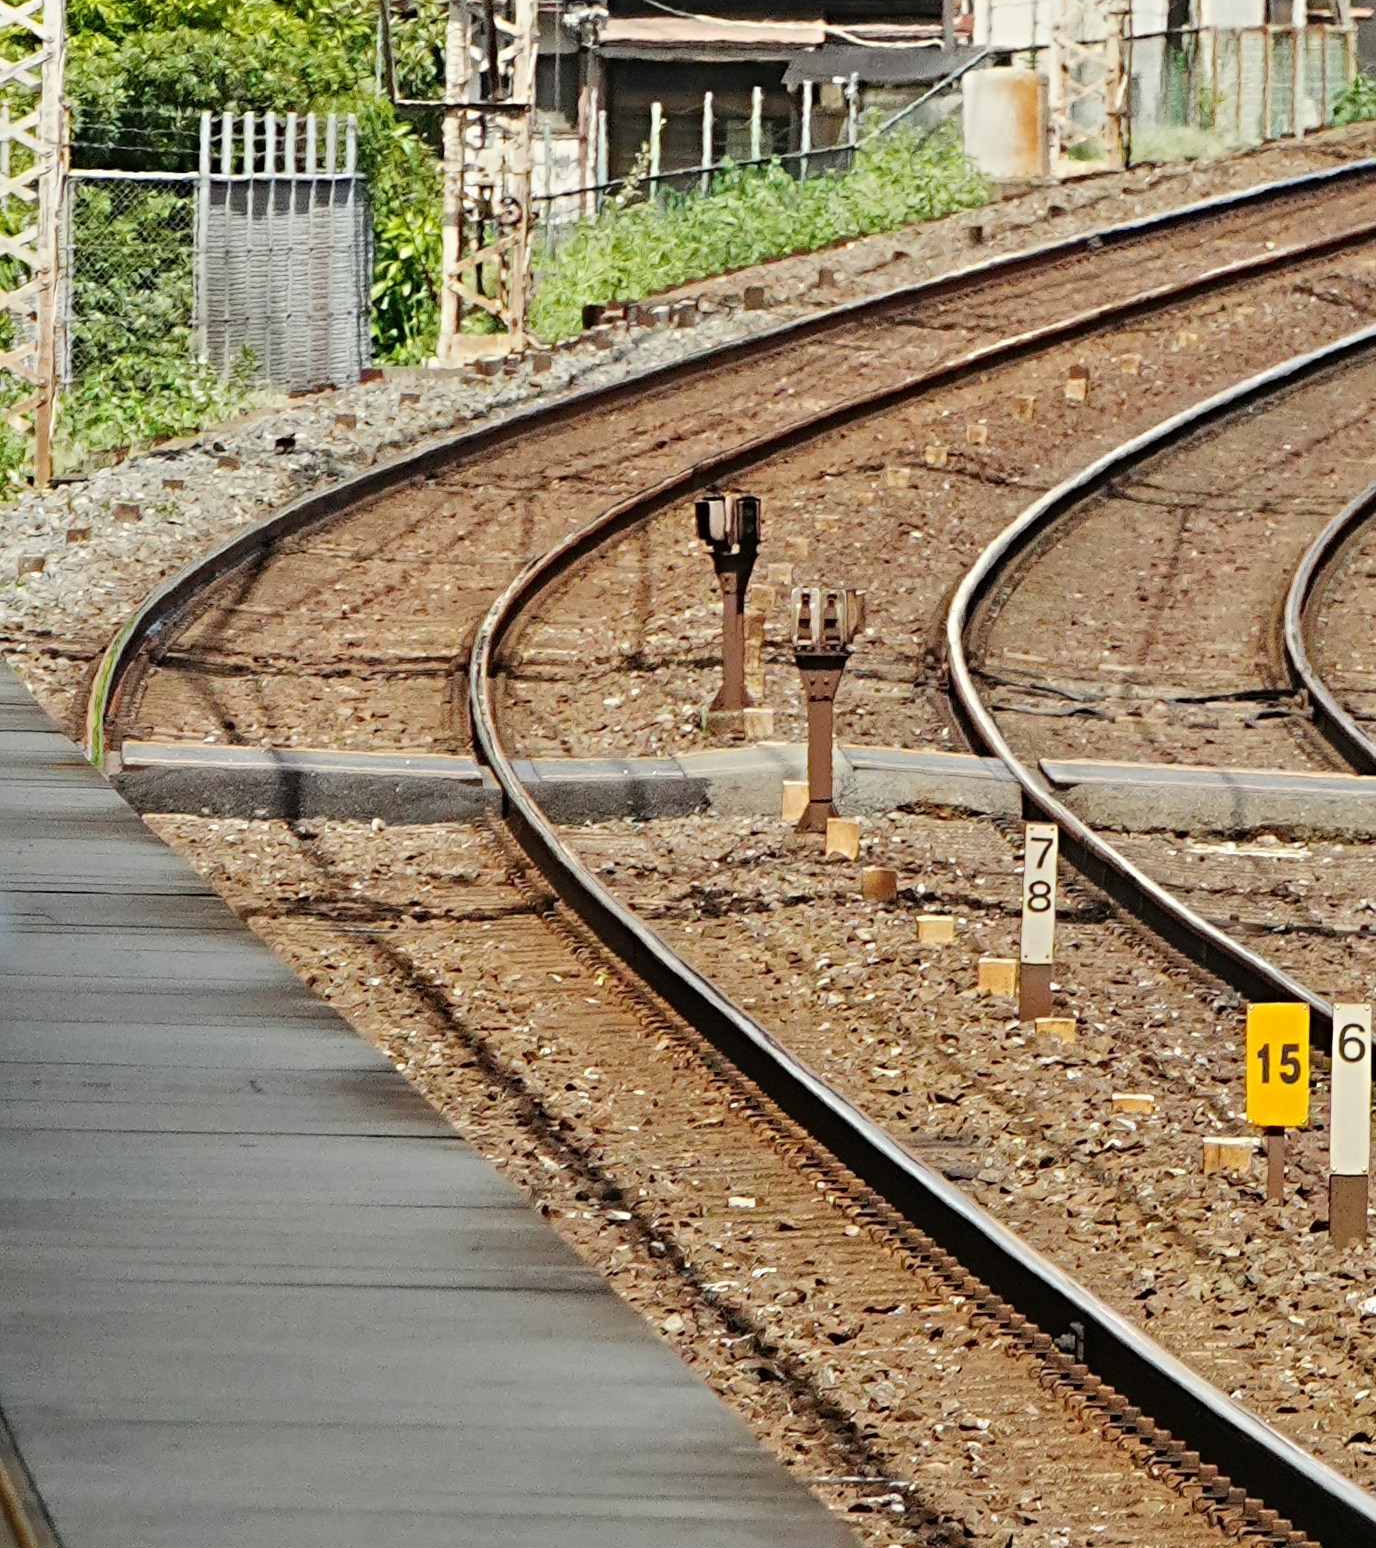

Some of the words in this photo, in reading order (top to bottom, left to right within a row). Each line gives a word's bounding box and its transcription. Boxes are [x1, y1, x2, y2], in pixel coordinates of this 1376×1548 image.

[1030, 837, 1054, 869] 7
[1027, 881, 1052, 913] 8
[1339, 1023, 1366, 1063] 6
[1257, 1043, 1301, 1085] 15
